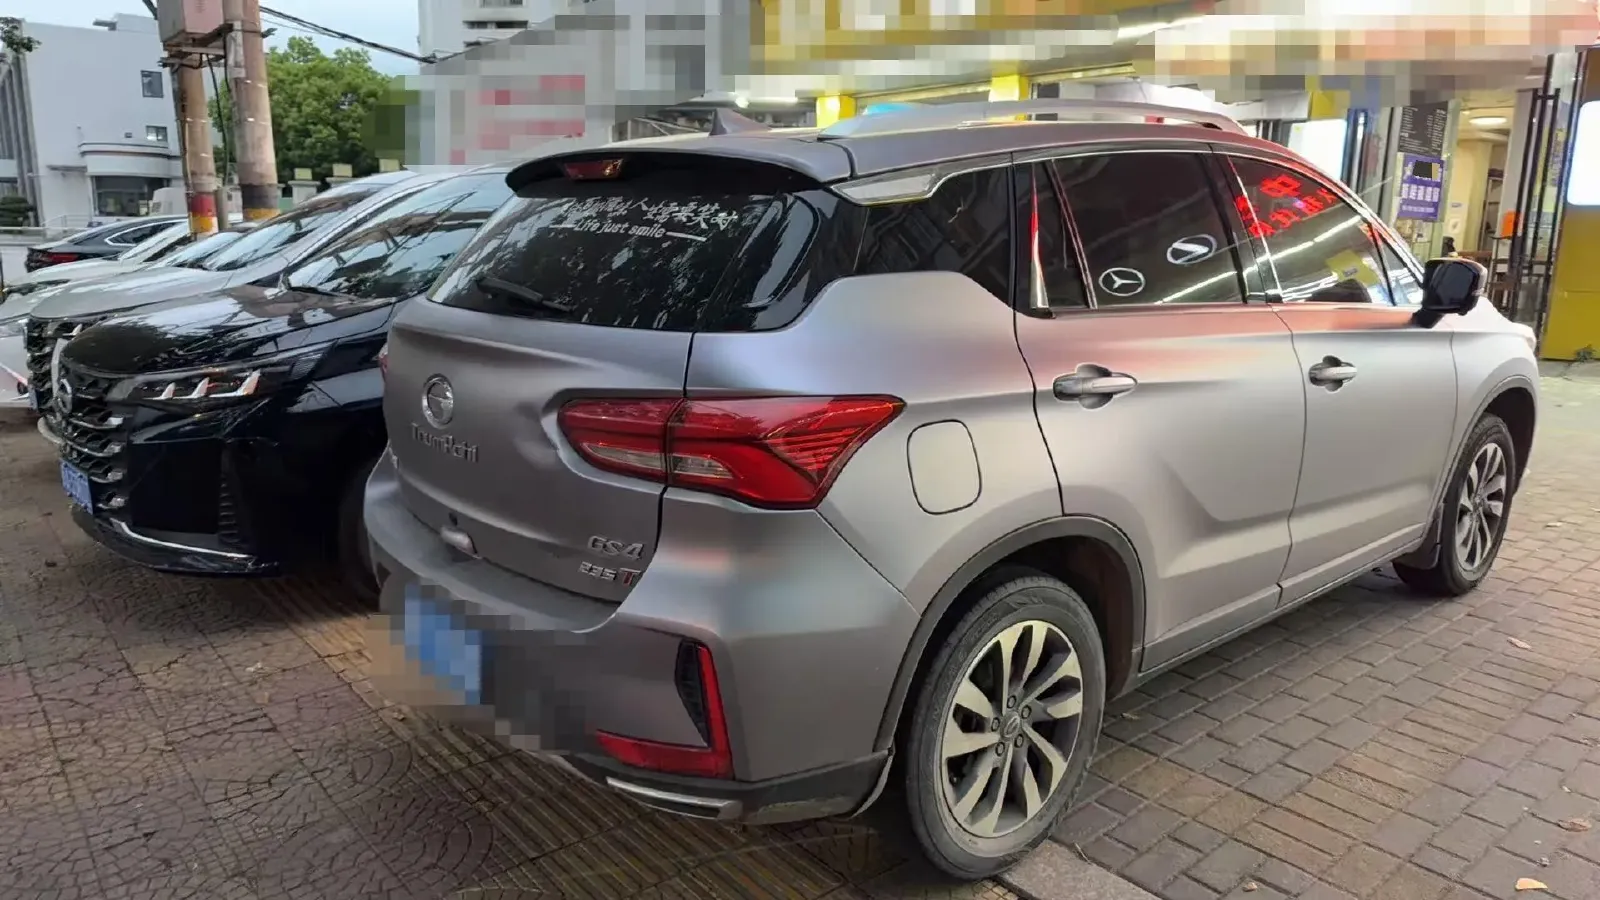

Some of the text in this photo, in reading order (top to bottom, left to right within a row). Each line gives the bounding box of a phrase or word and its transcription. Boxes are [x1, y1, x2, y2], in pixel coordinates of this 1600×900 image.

[573, 219, 667, 238] Life just smile
[587, 535, 644, 561] GS4
